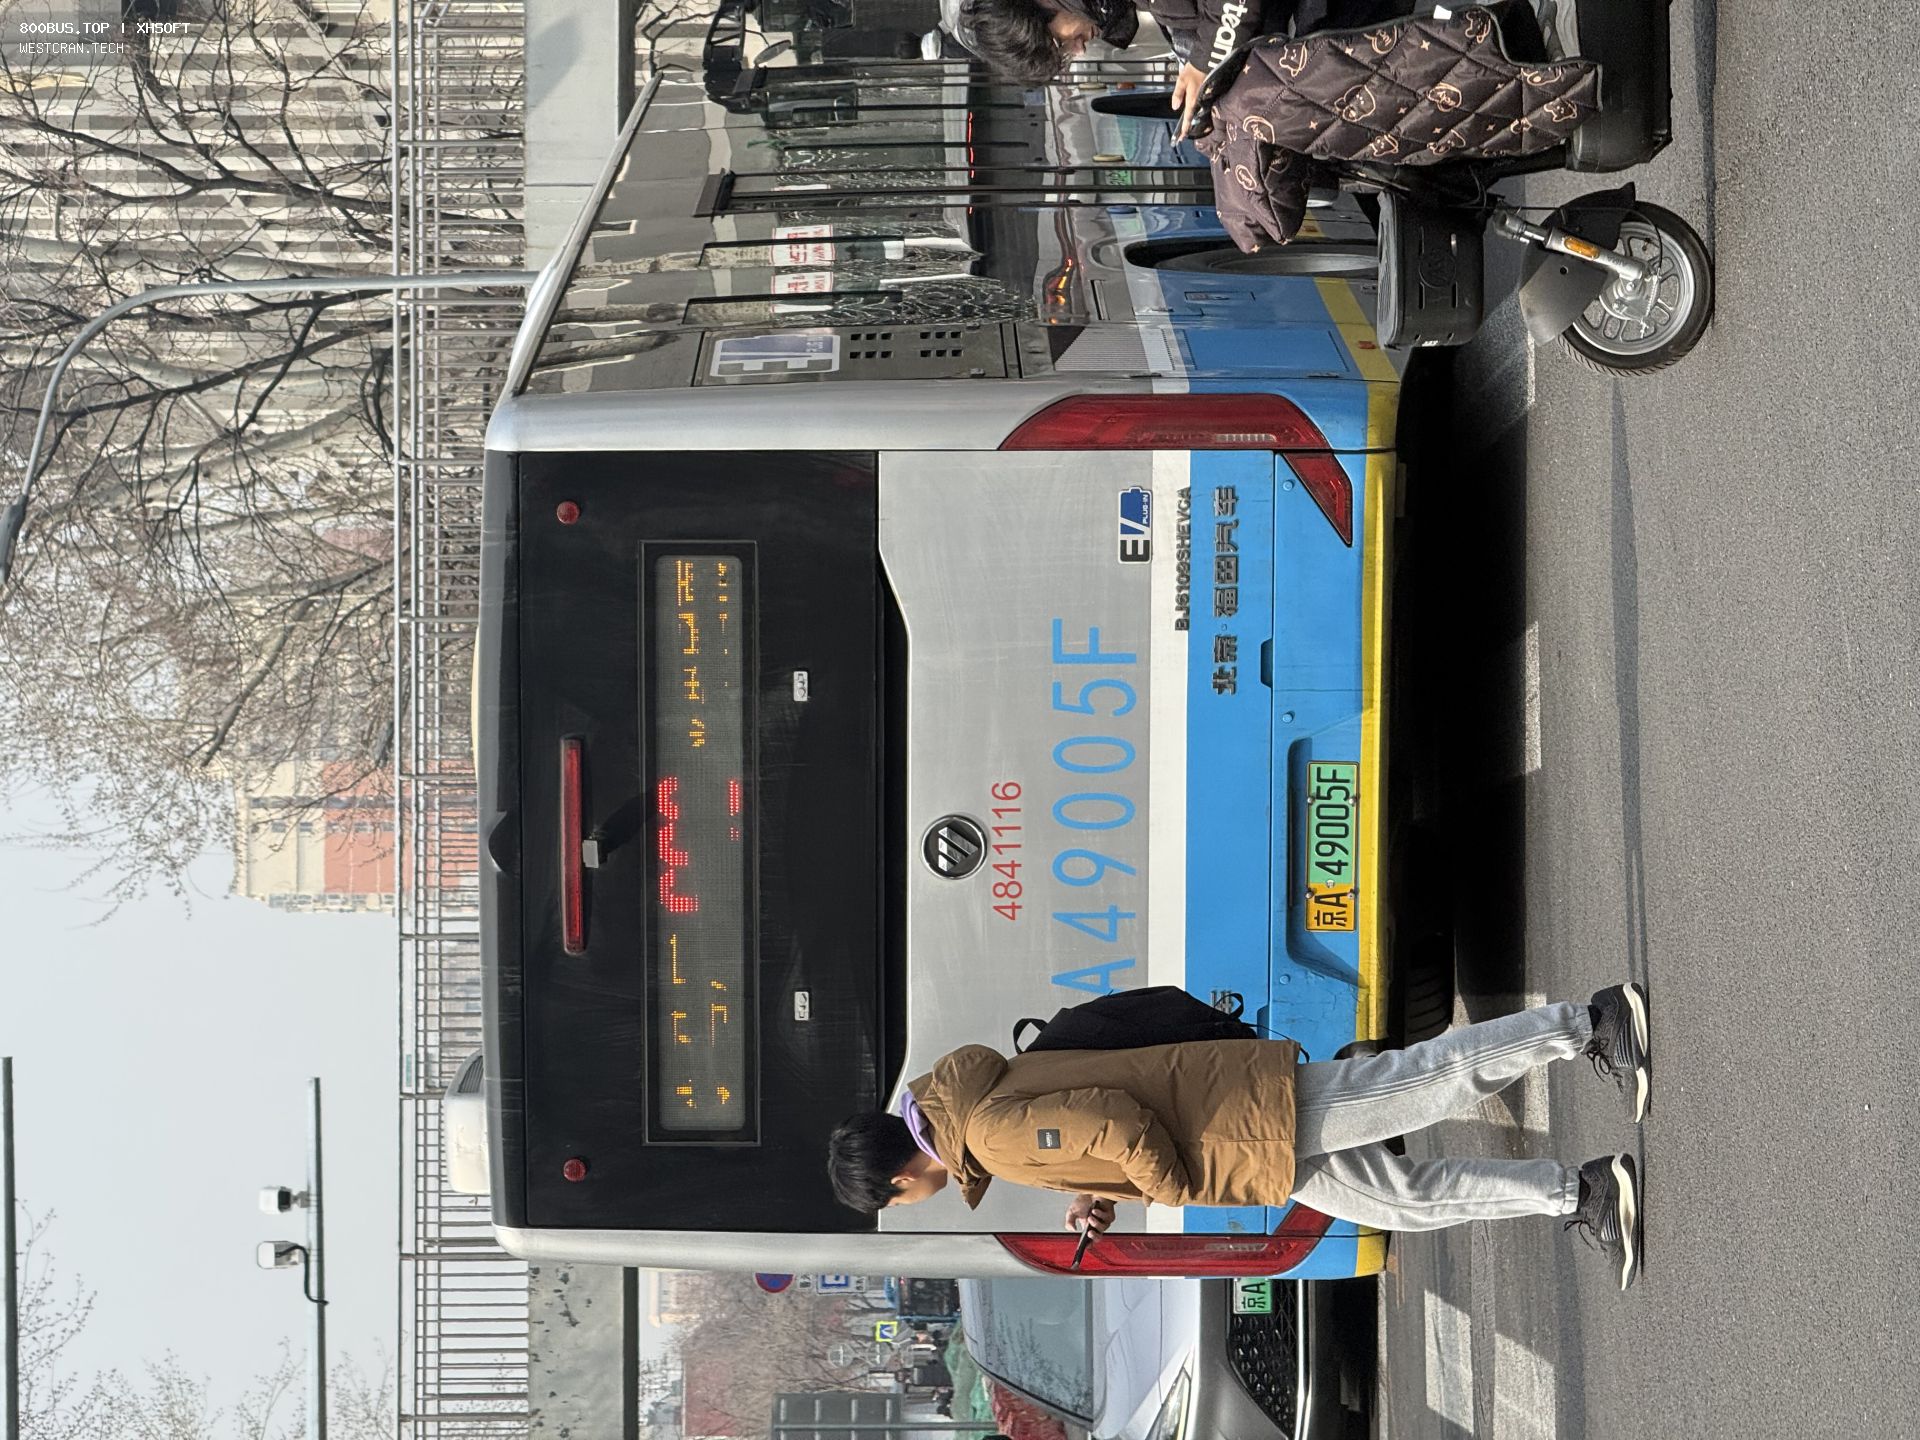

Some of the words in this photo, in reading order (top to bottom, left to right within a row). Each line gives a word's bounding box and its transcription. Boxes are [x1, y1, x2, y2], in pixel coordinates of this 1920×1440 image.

[1174, 486, 1191, 632] BJ6109SHEVCA
[991, 781, 1023, 921] 4841116
[1050, 617, 1138, 995] A49005F
[1241, 1282, 1266, 1309] 京A
